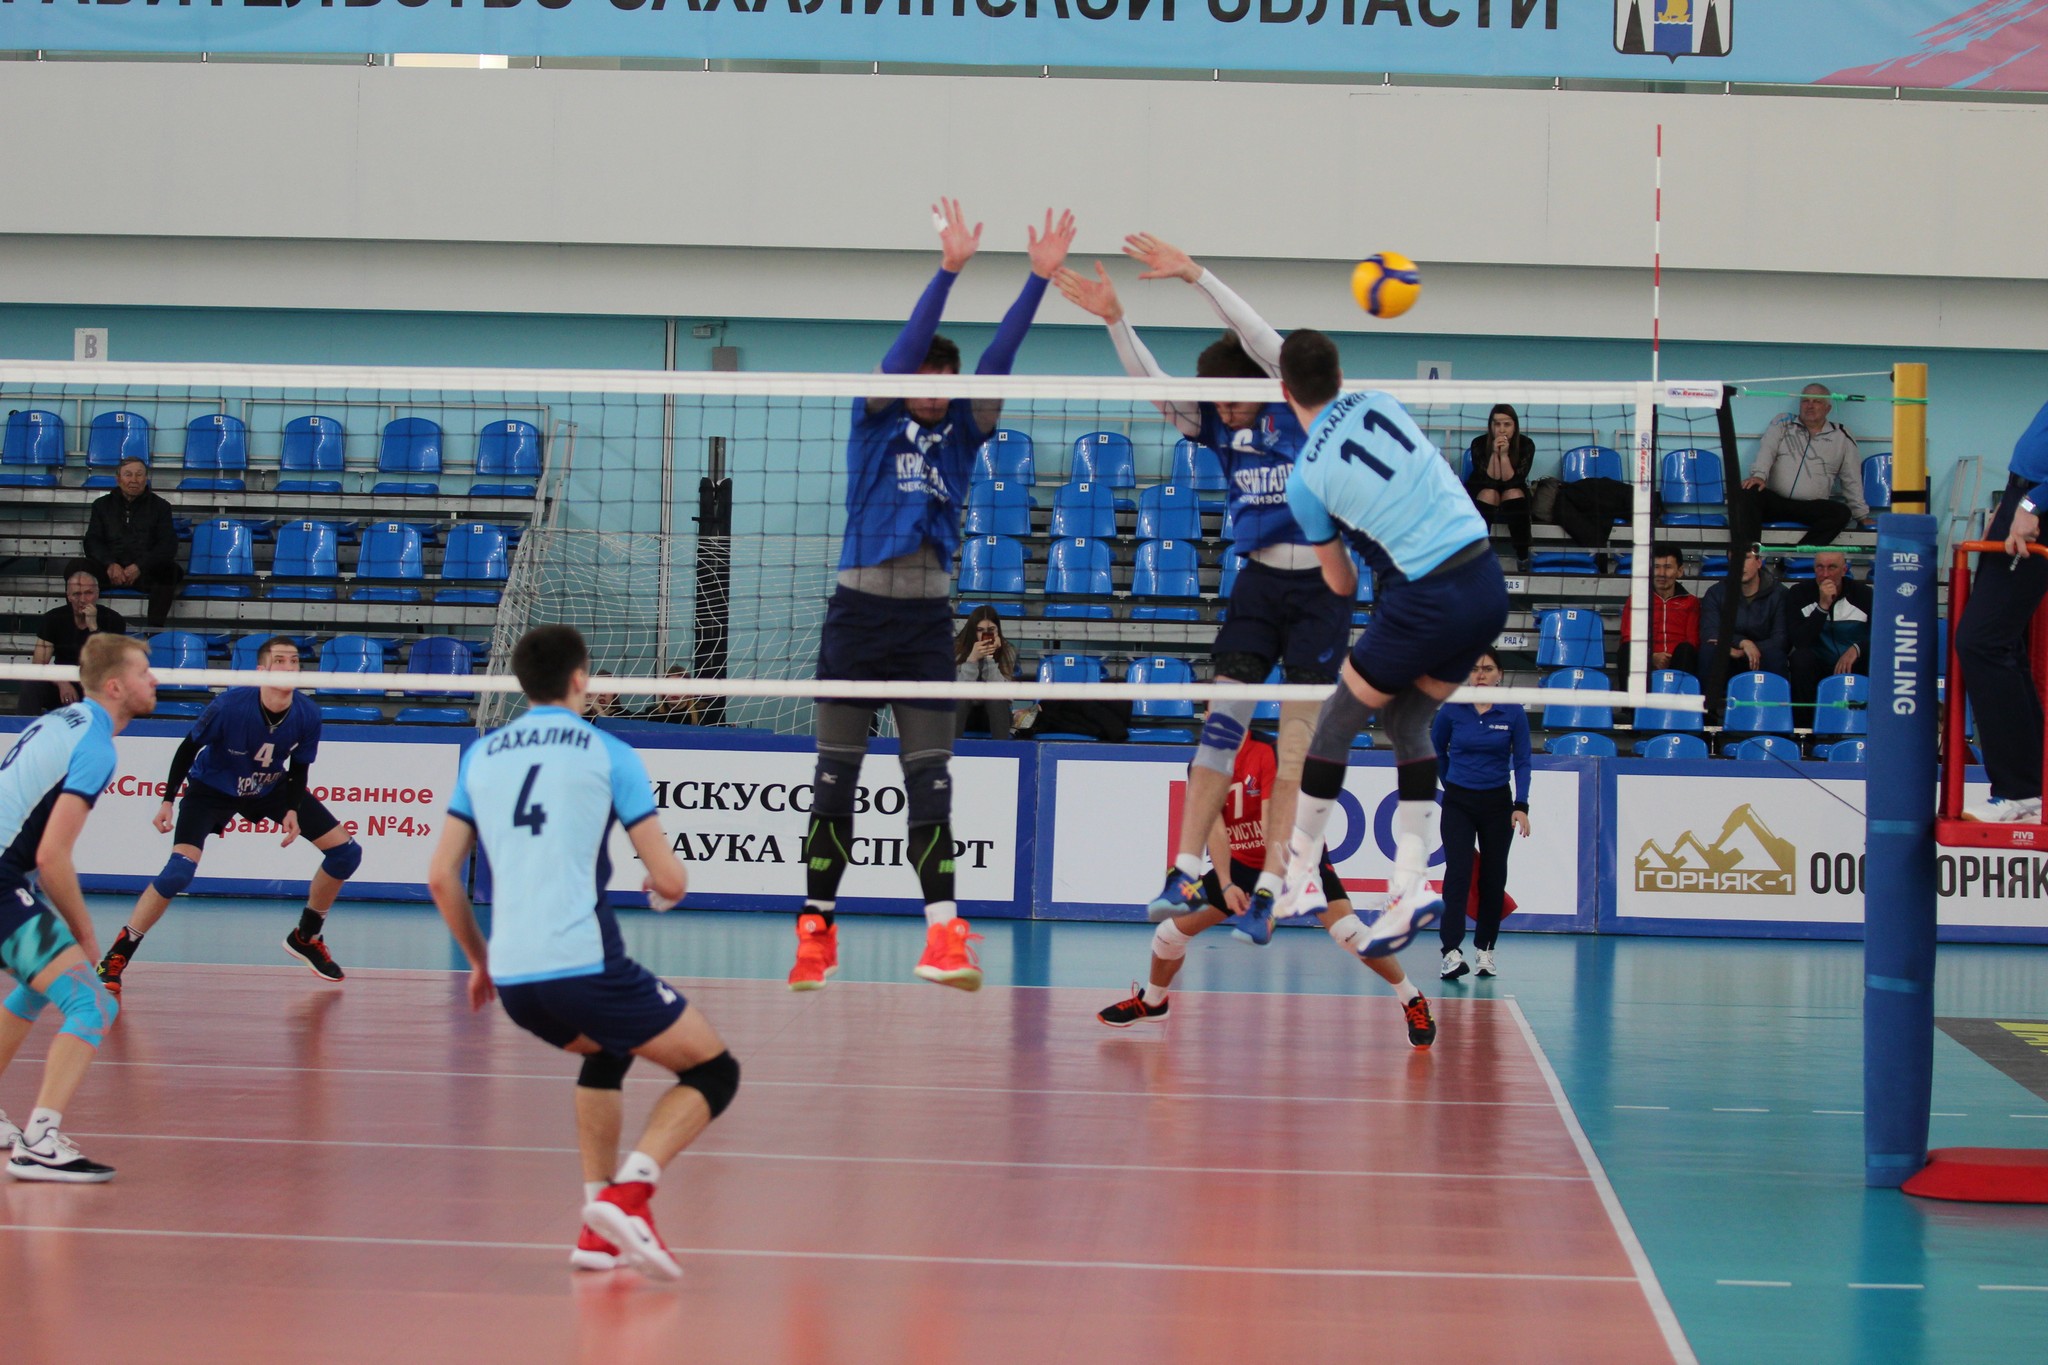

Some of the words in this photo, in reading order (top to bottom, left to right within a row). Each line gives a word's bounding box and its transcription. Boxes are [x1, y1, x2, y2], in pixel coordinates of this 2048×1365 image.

[1340, 408, 1417, 482] 11
[1892, 552, 1919, 563] FIVB
[1503, 636, 1517, 645] РЯД
[1892, 614, 1918, 715] JINLING
[0, 723, 43, 771] 8
[254, 742, 275, 768] 4
[486, 726, 592, 756] САХАЛИН
[513, 763, 548, 837] 4
[649, 780, 906, 815] ИСКУССВО
[367, 815, 432, 837] №4»
[2013, 830, 2034, 840] FIVB
[1638, 869, 1793, 892] ГОРНЯК-1
[1810, 852, 1866, 895] ОО
